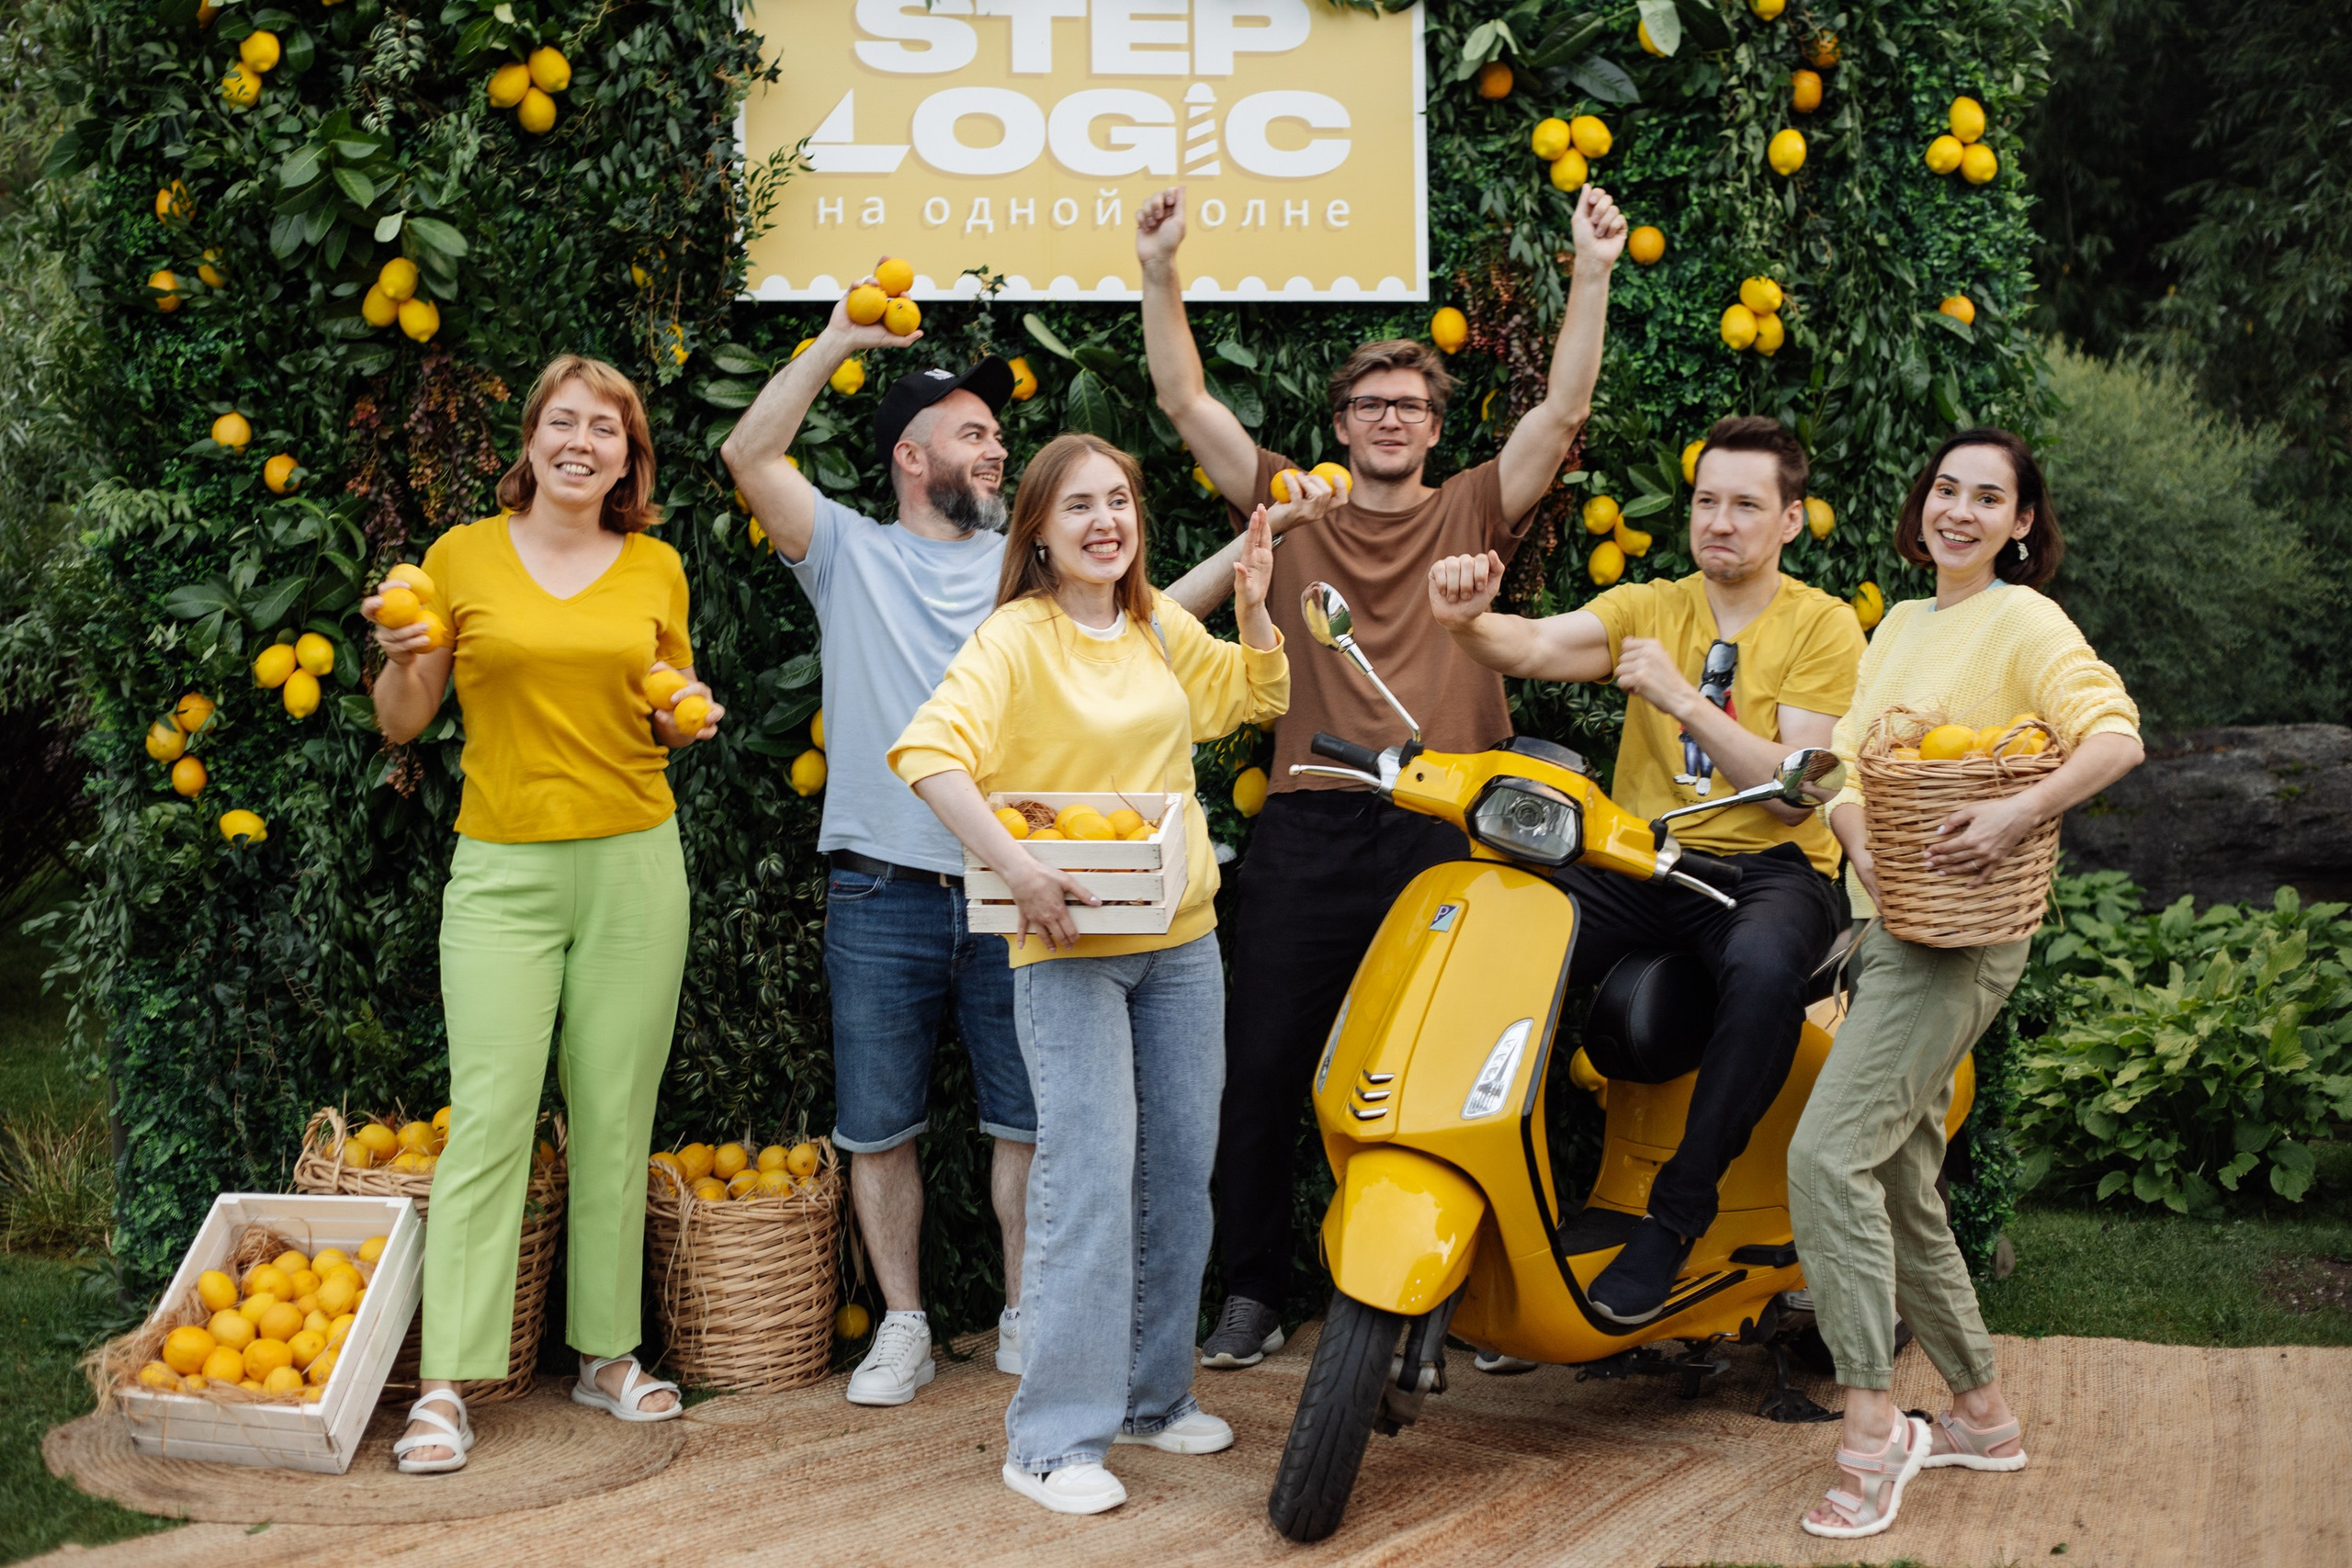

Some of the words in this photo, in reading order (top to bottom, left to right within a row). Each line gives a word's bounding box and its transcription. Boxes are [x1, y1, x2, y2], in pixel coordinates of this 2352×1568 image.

[854, 0, 1312, 75] STEP
[818, 196, 886, 225] на
[923, 187, 1123, 233] одной
[1200, 198, 1351, 227] олне
